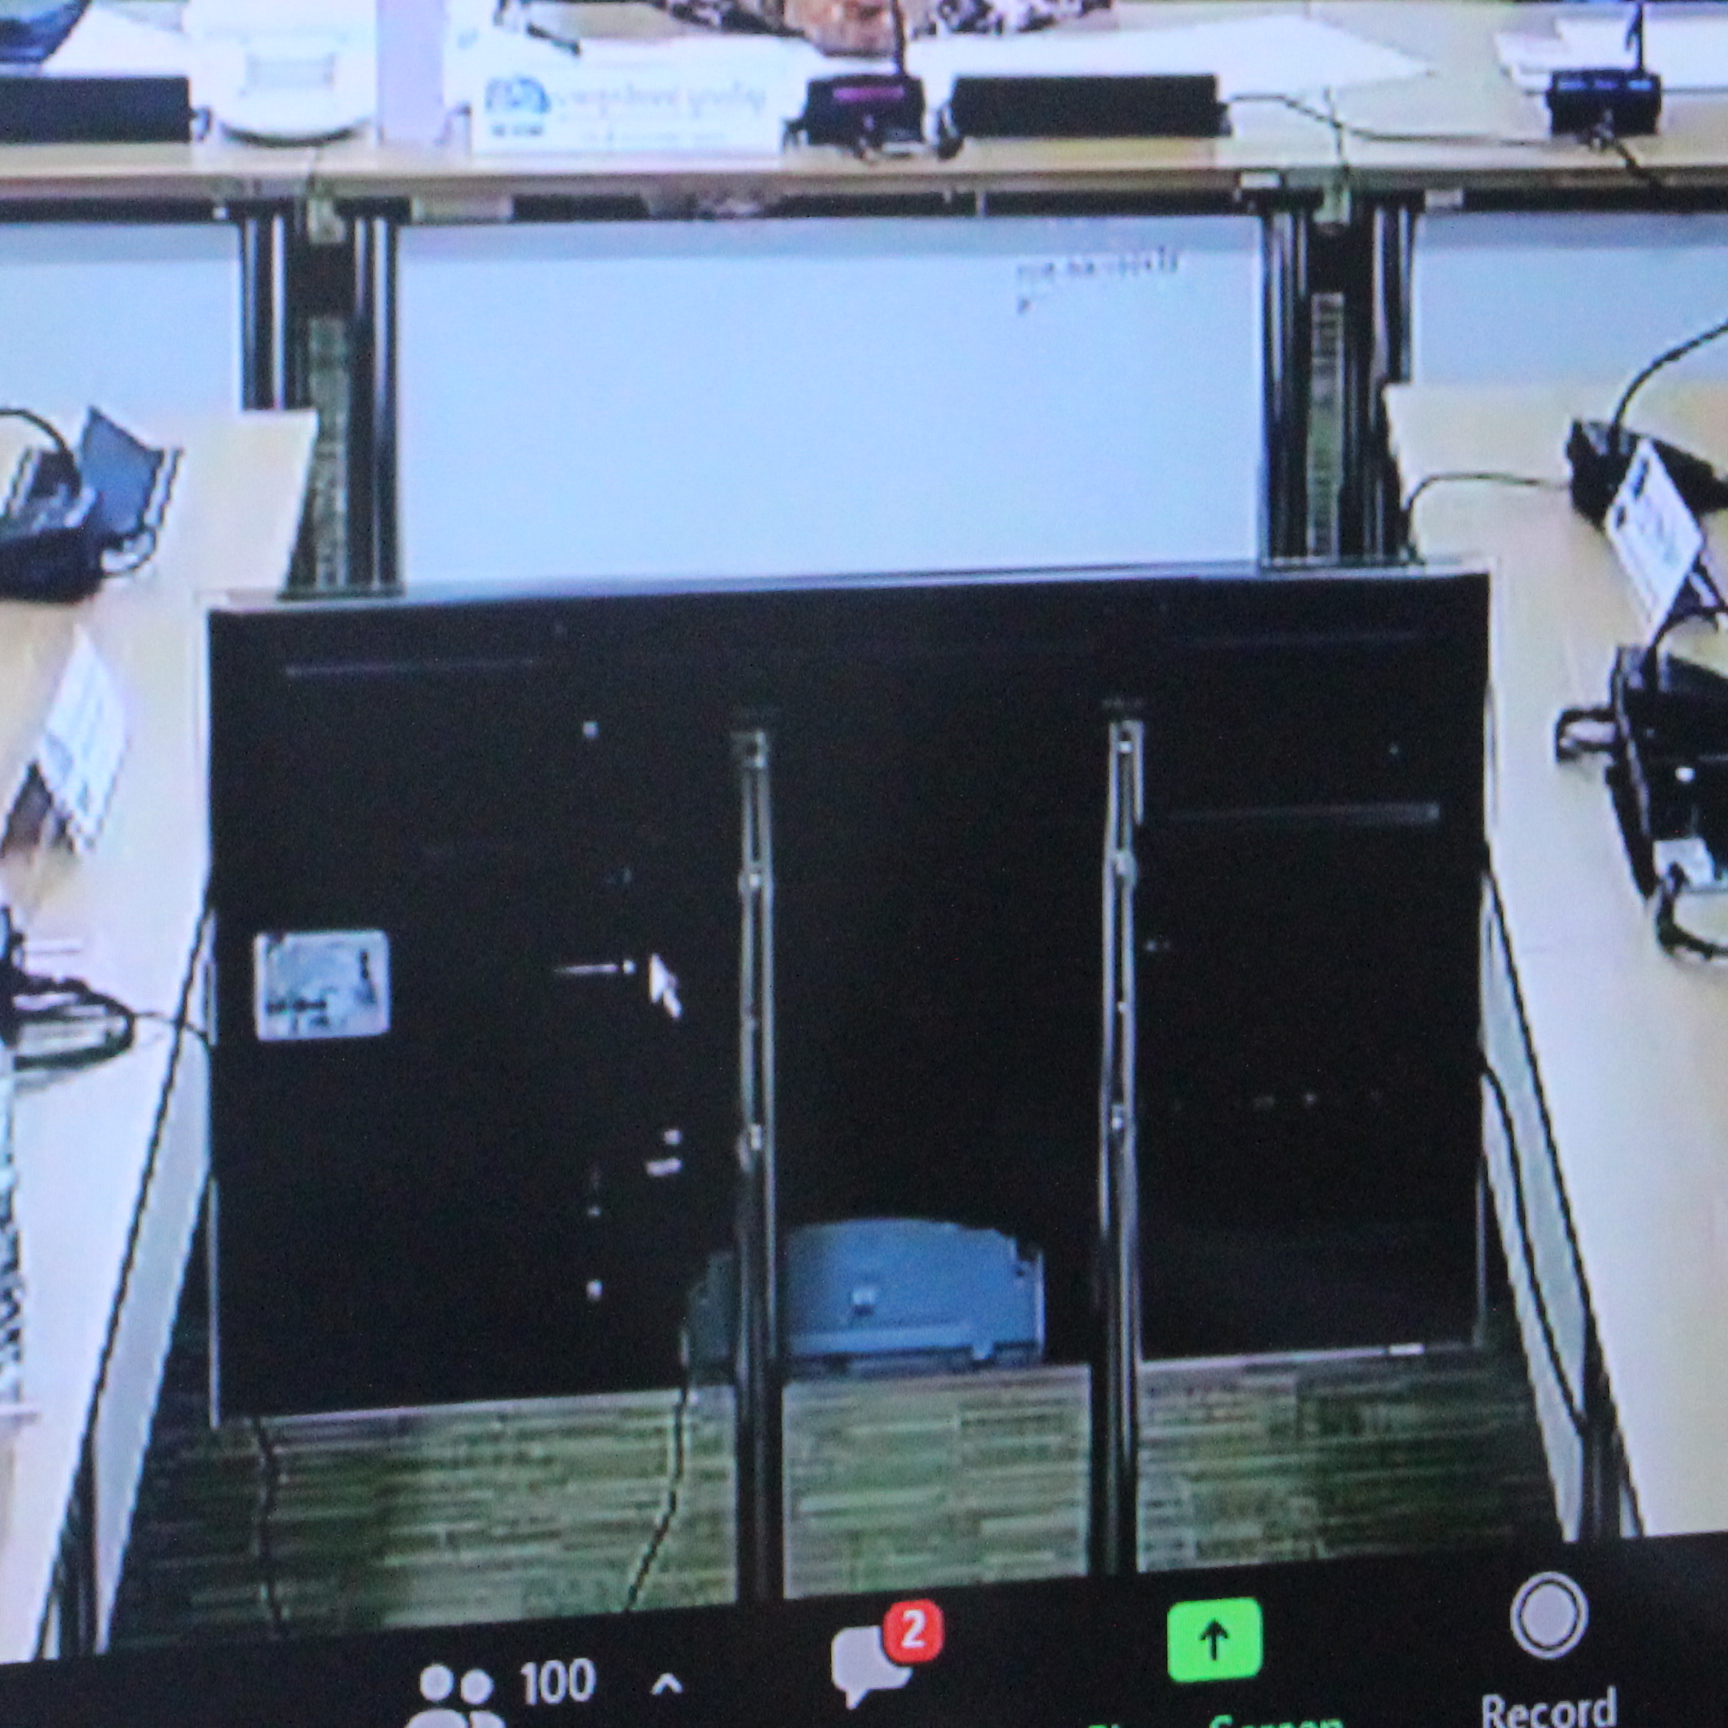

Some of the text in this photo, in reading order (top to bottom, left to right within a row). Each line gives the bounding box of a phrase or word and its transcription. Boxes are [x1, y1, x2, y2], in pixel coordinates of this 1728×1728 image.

[900, 1608, 927, 1648] 2
[519, 1656, 597, 1707] 100
[1481, 1683, 1618, 1728] Record
